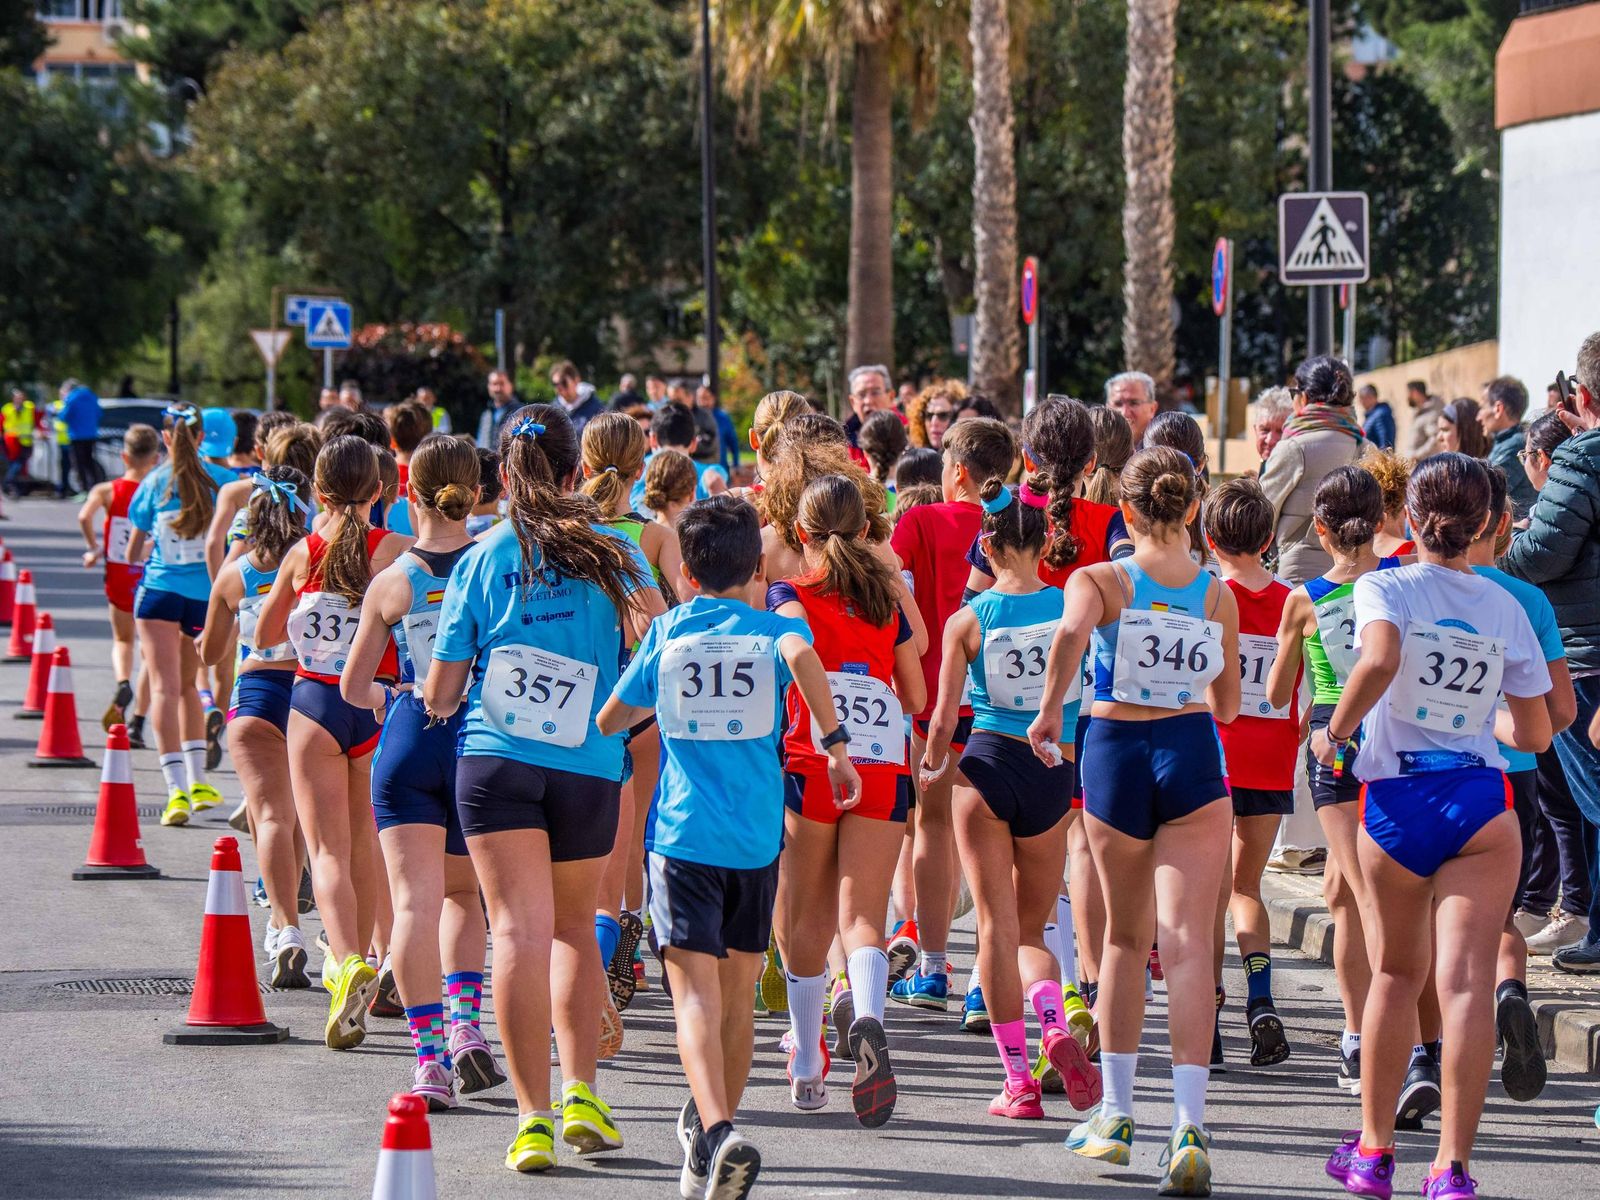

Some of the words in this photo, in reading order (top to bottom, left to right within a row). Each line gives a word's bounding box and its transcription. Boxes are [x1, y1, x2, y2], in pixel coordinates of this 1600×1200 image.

[302, 611, 361, 645] 337
[535, 610, 575, 624] cajamar
[1005, 645, 1052, 679] 33
[1137, 634, 1209, 673] 346
[1238, 653, 1276, 685] 31
[504, 667, 577, 710] 357
[681, 661, 755, 698] 315
[1418, 651, 1489, 695] 322
[832, 694, 890, 728] 352
